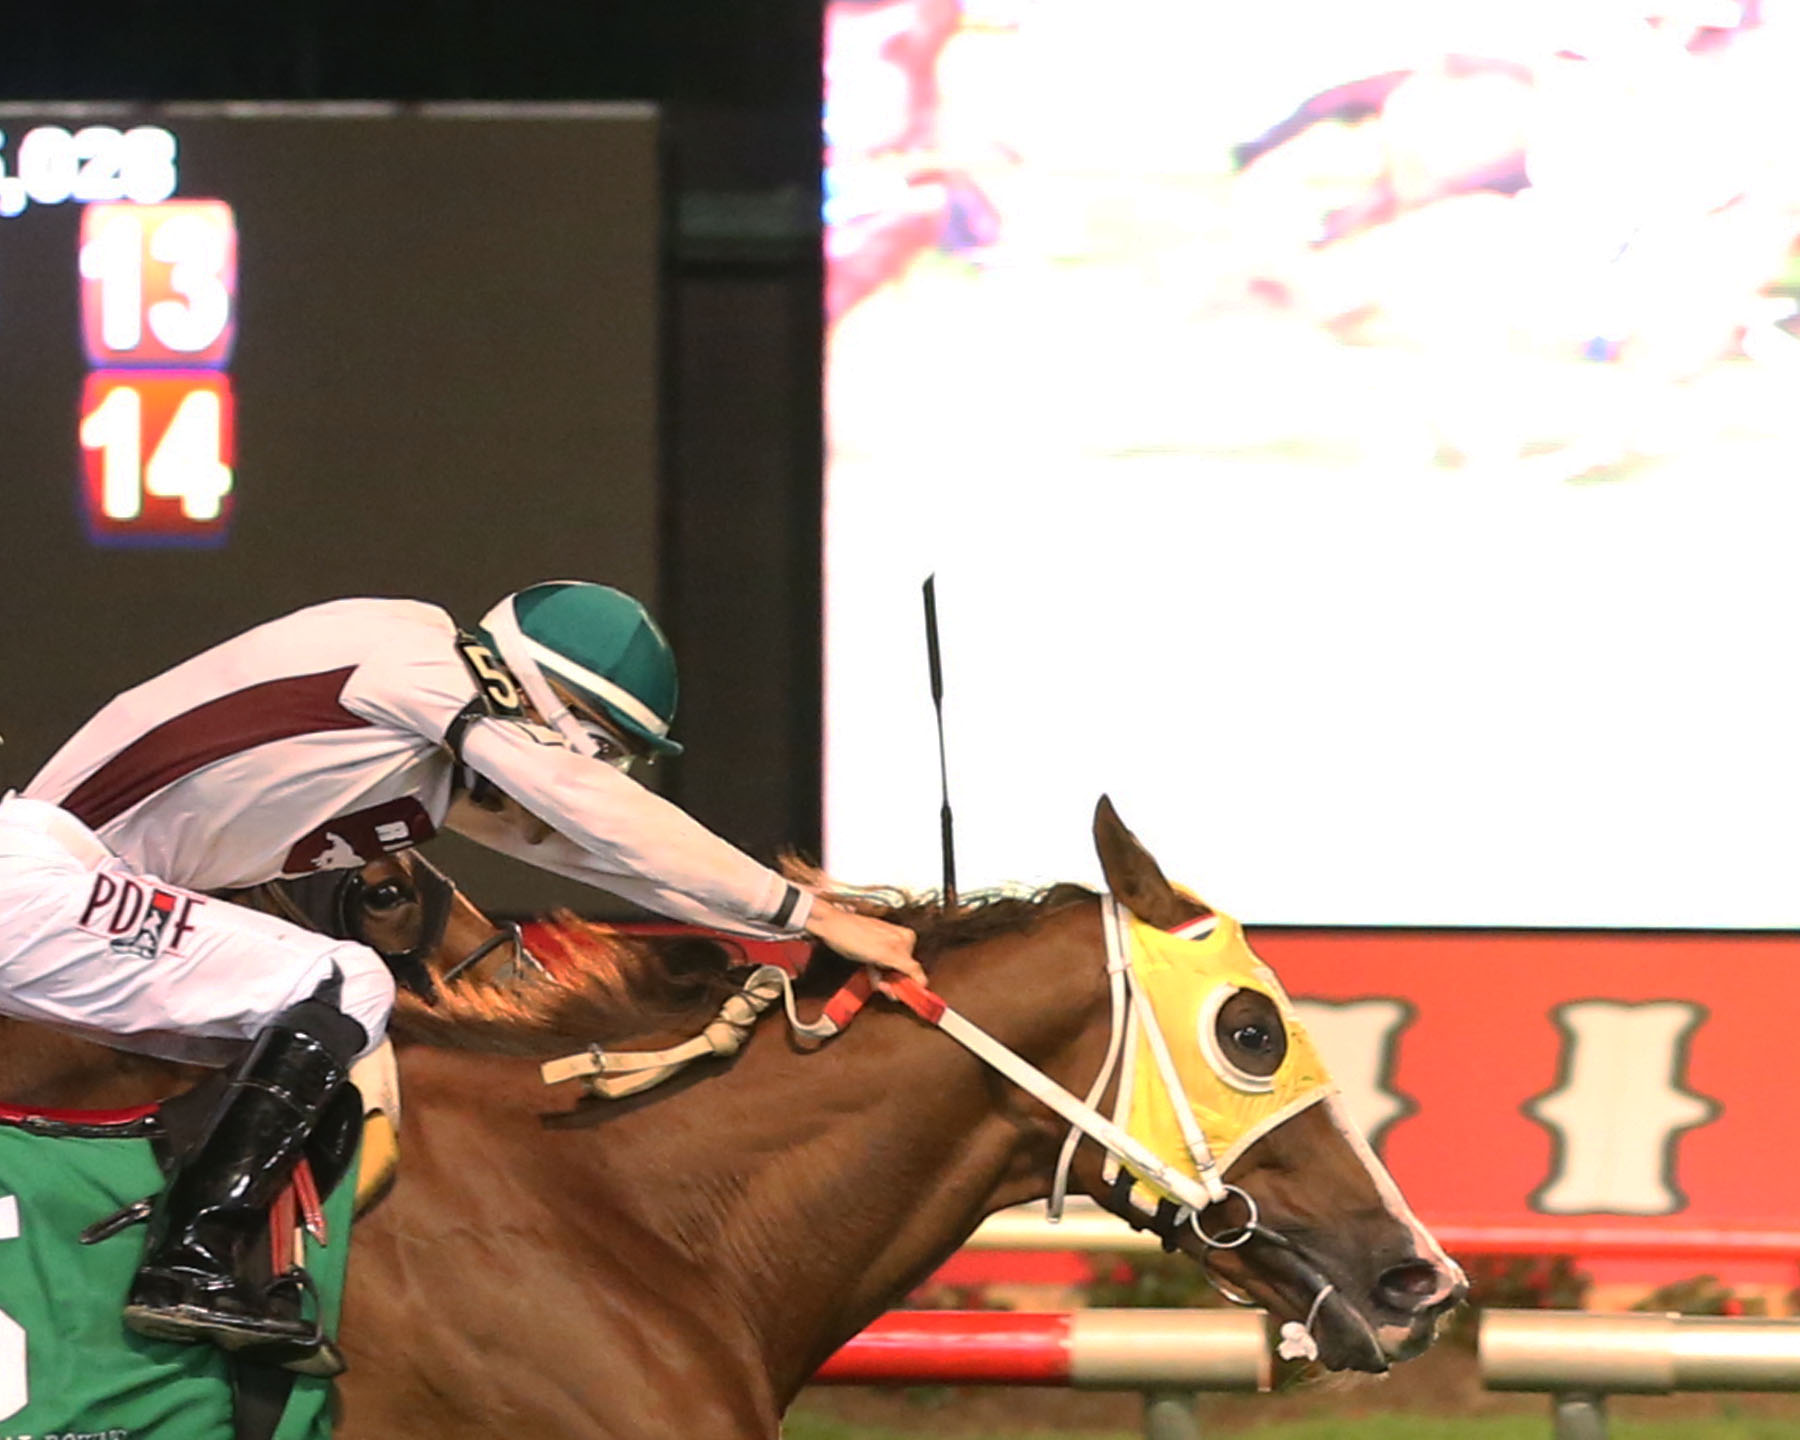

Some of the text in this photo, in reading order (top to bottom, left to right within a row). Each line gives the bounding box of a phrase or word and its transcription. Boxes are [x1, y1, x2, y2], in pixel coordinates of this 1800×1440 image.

[80, 212, 230, 351] 13
[80, 387, 232, 519] 14
[463, 644, 520, 710] 5
